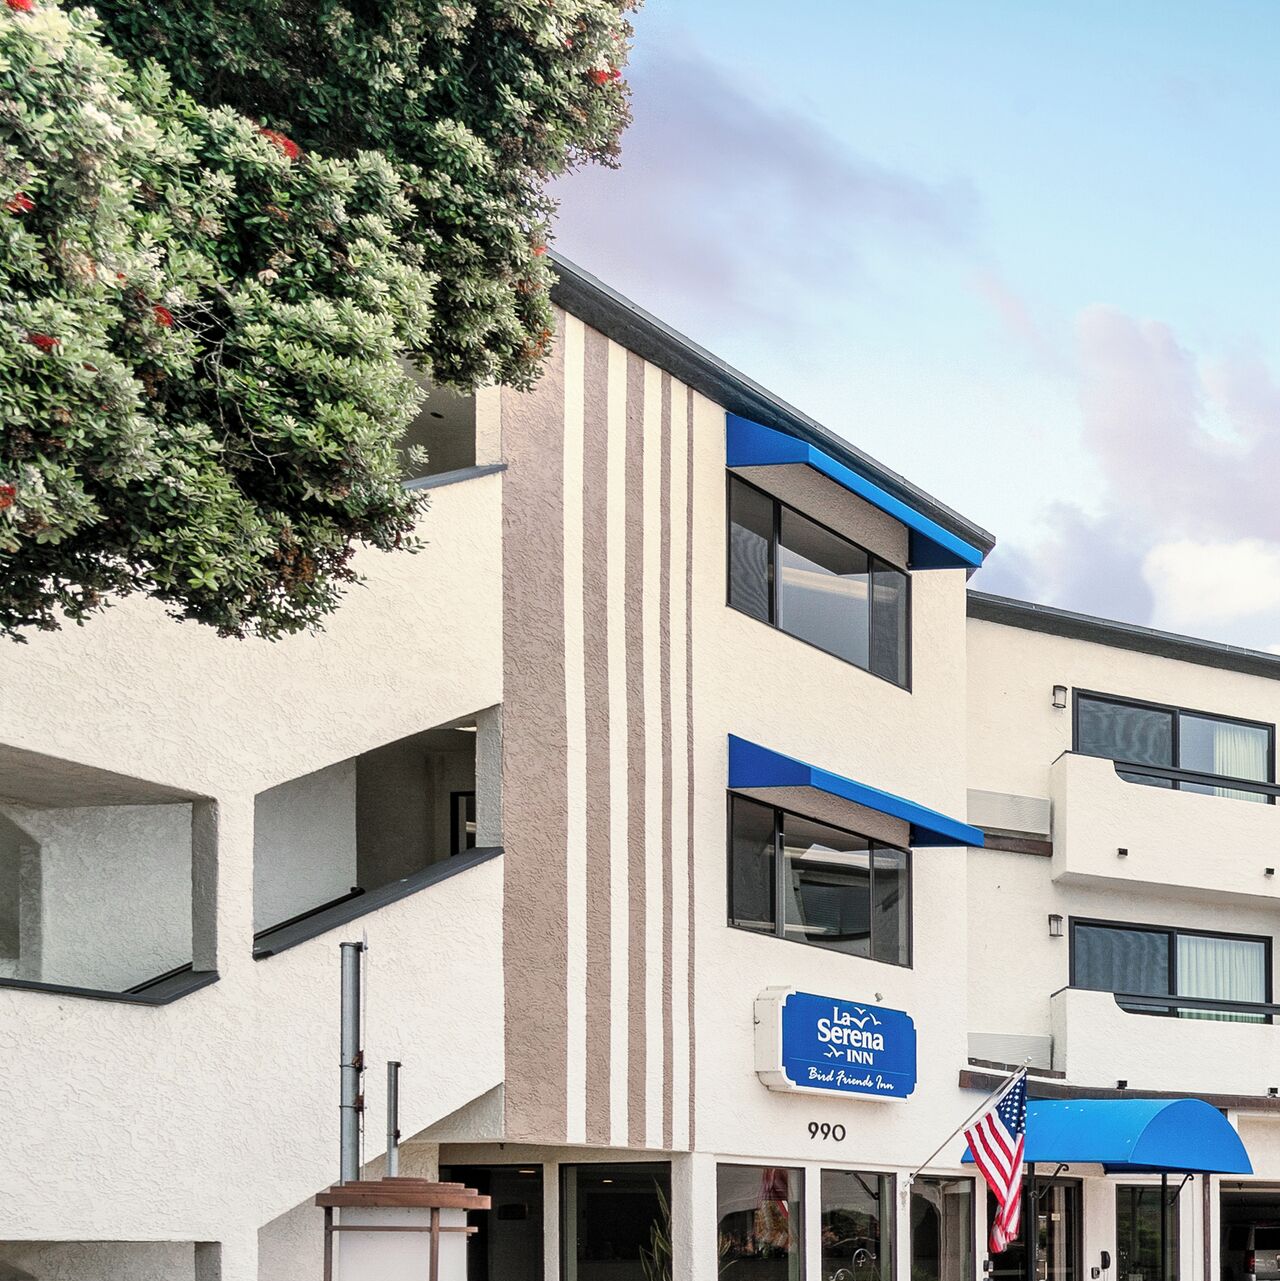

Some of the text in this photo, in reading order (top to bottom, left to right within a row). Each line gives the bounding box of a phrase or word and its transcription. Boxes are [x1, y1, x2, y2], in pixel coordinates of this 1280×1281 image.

[833, 1006, 851, 1026] La
[817, 1018, 884, 1051] Serena
[846, 1049, 874, 1065] INN
[808, 1066, 894, 1090] Bird Friends Inn
[807, 1122, 846, 1141] 990
